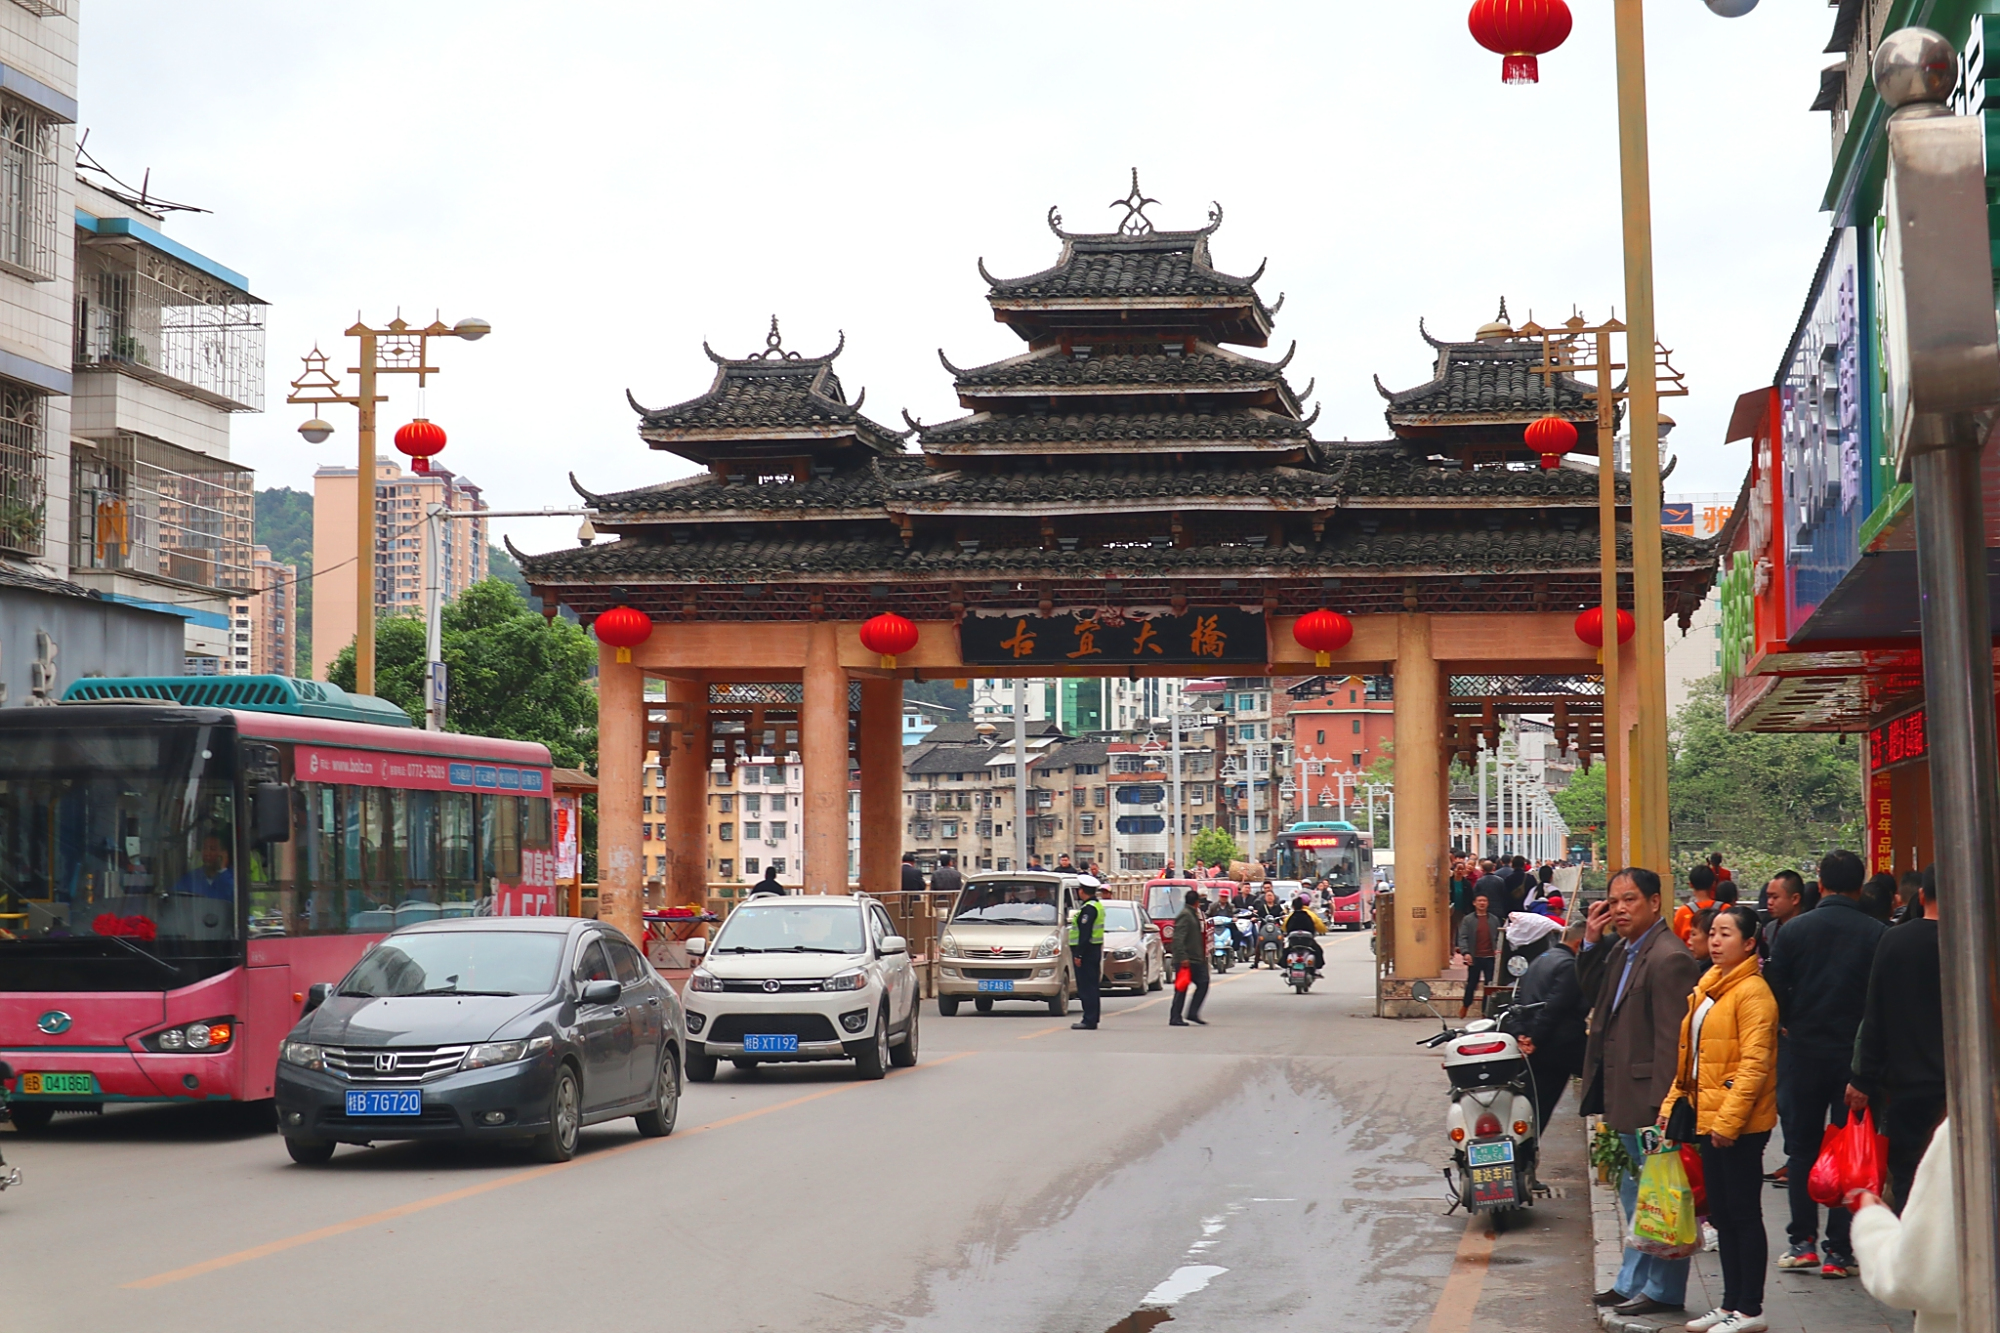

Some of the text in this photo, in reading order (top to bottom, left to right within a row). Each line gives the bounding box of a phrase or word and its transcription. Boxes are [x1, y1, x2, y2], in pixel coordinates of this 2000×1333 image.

[1877, 798, 1891, 873] 百年品牌
[522, 850, 554, 886] 取息宝
